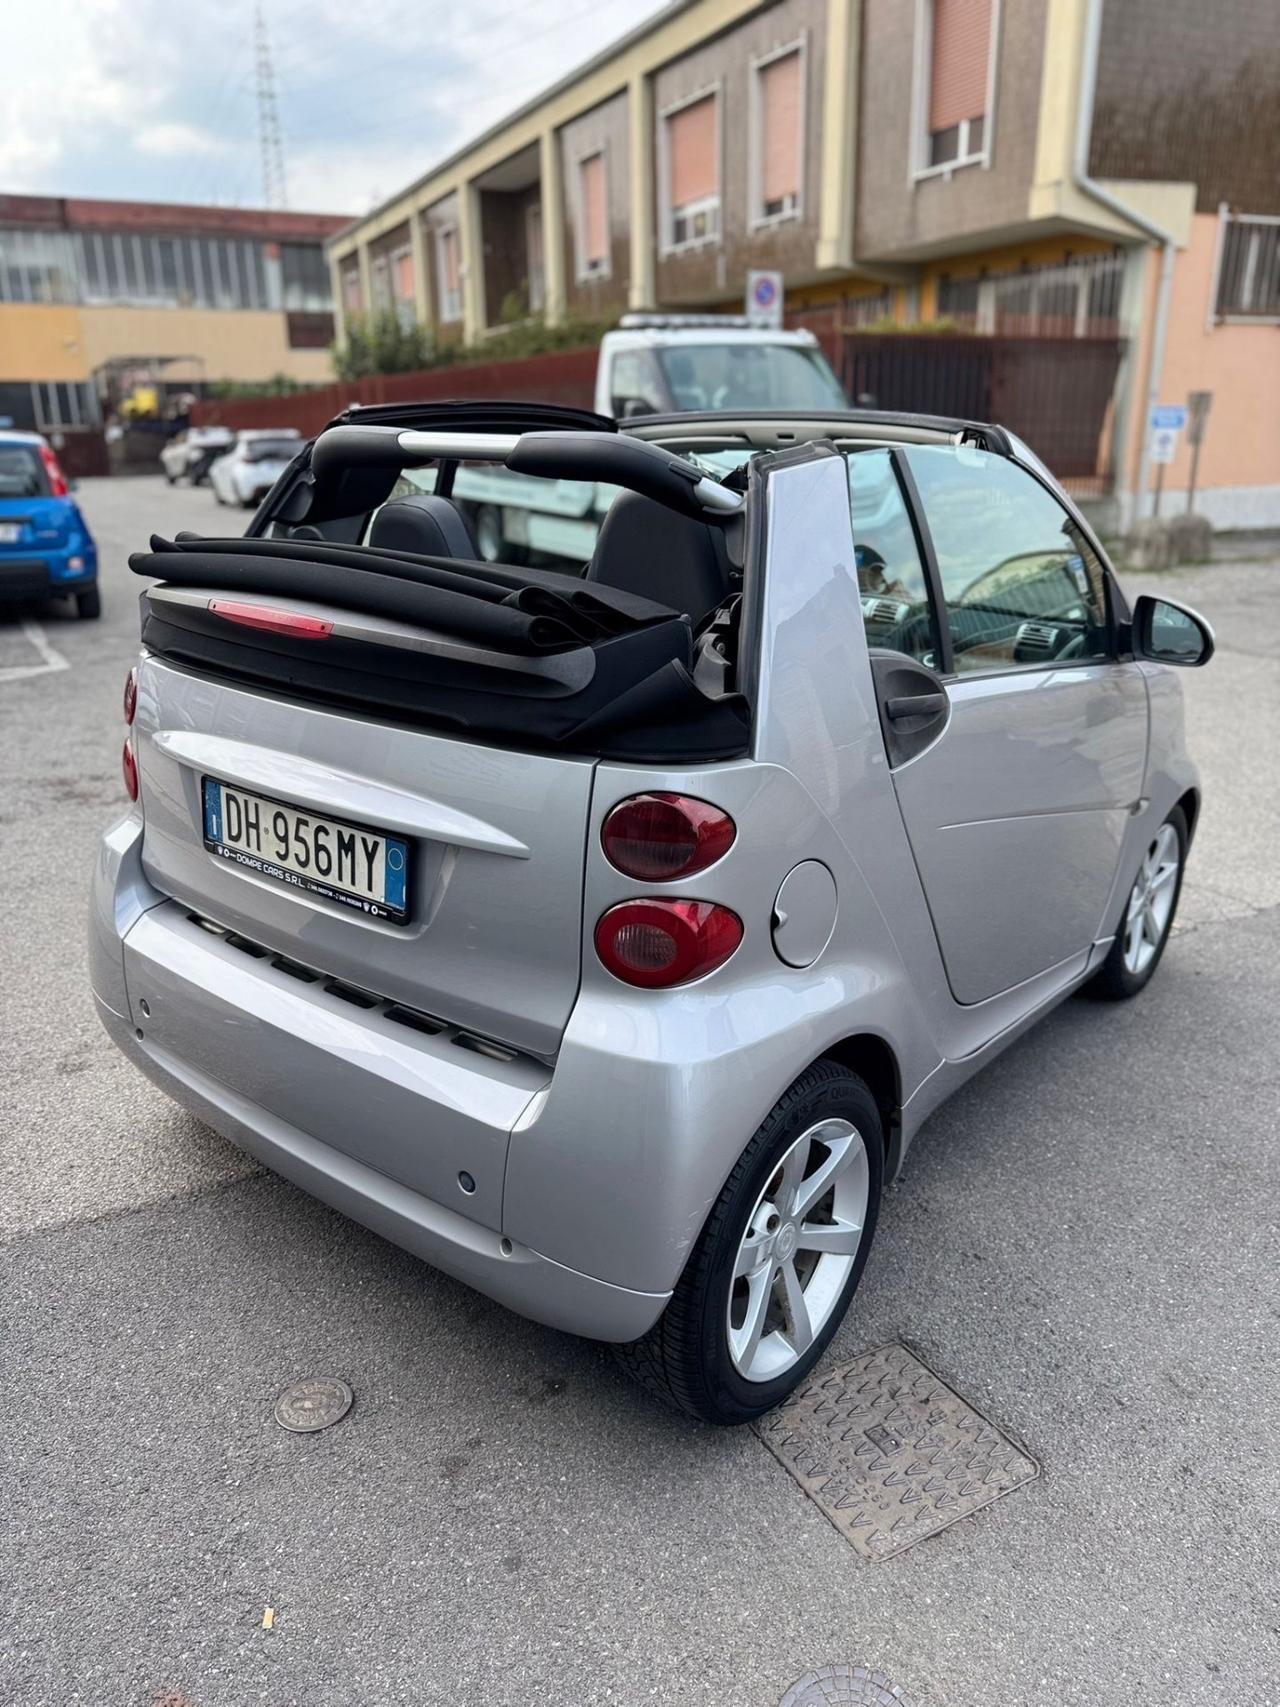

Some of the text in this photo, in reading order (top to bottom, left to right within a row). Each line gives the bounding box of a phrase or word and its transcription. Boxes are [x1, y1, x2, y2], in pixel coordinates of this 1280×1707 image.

[225, 792, 380, 892] DH 956MY
[236, 853, 262, 871] DOMPE
[263, 864, 284, 880] CARS
